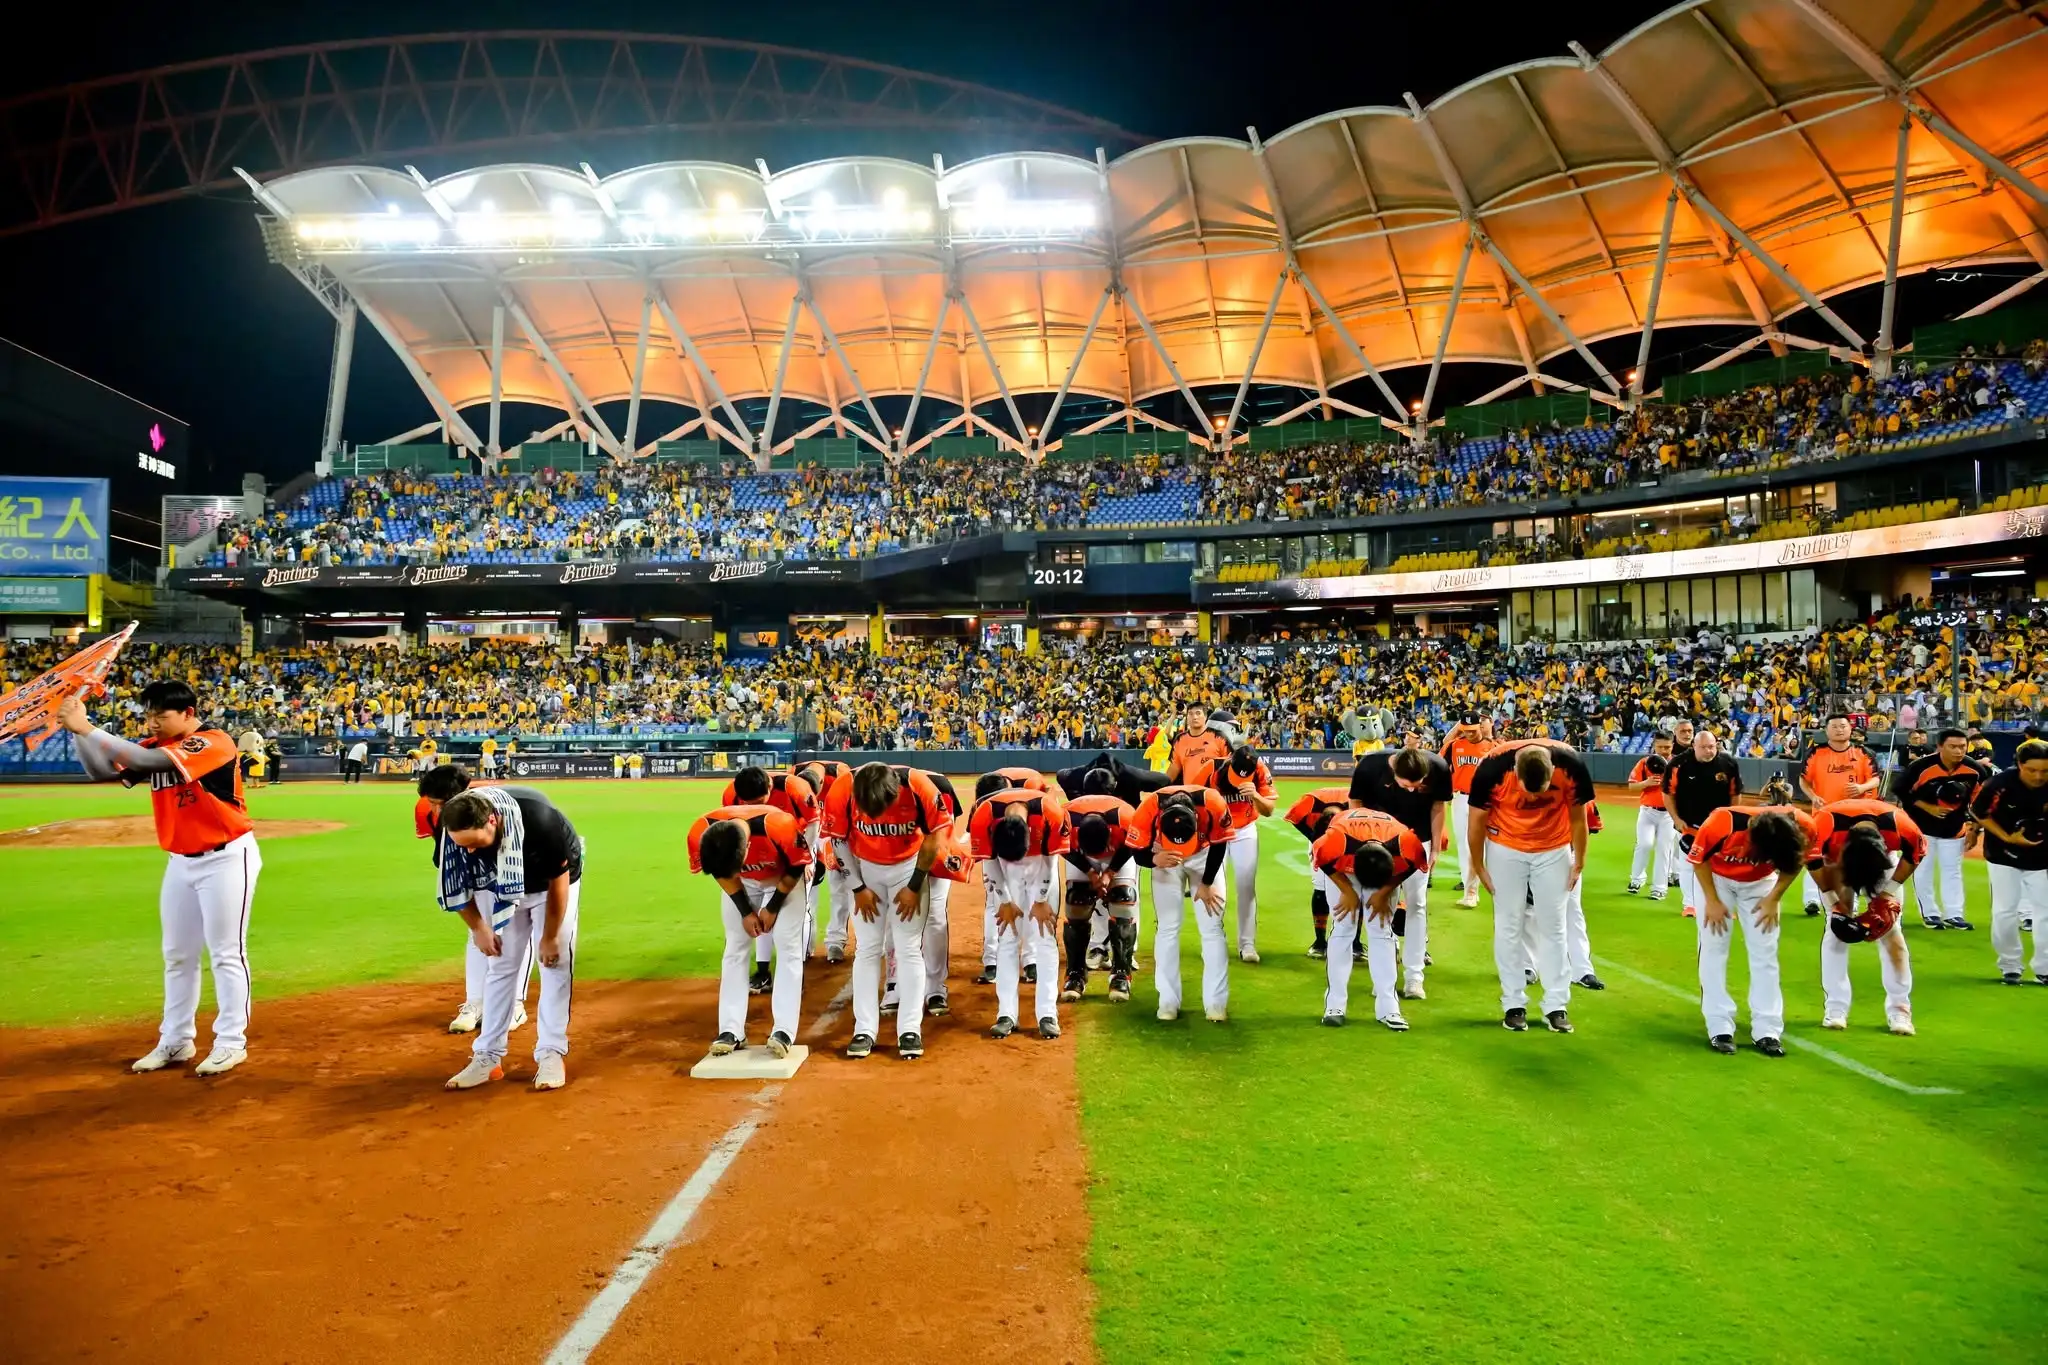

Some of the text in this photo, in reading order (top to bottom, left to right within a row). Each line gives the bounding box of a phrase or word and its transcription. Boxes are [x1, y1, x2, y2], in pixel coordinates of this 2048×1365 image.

[52, 544, 94, 560] Ltd.
[1777, 533, 1852, 564] Brothers
[262, 566, 320, 588] Brothers
[411, 564, 468, 586] Brothers
[559, 562, 617, 584] Brothers
[709, 560, 767, 582] Brothers
[1033, 569, 1084, 585] 20:12
[856, 820, 916, 837] UNILIONS
